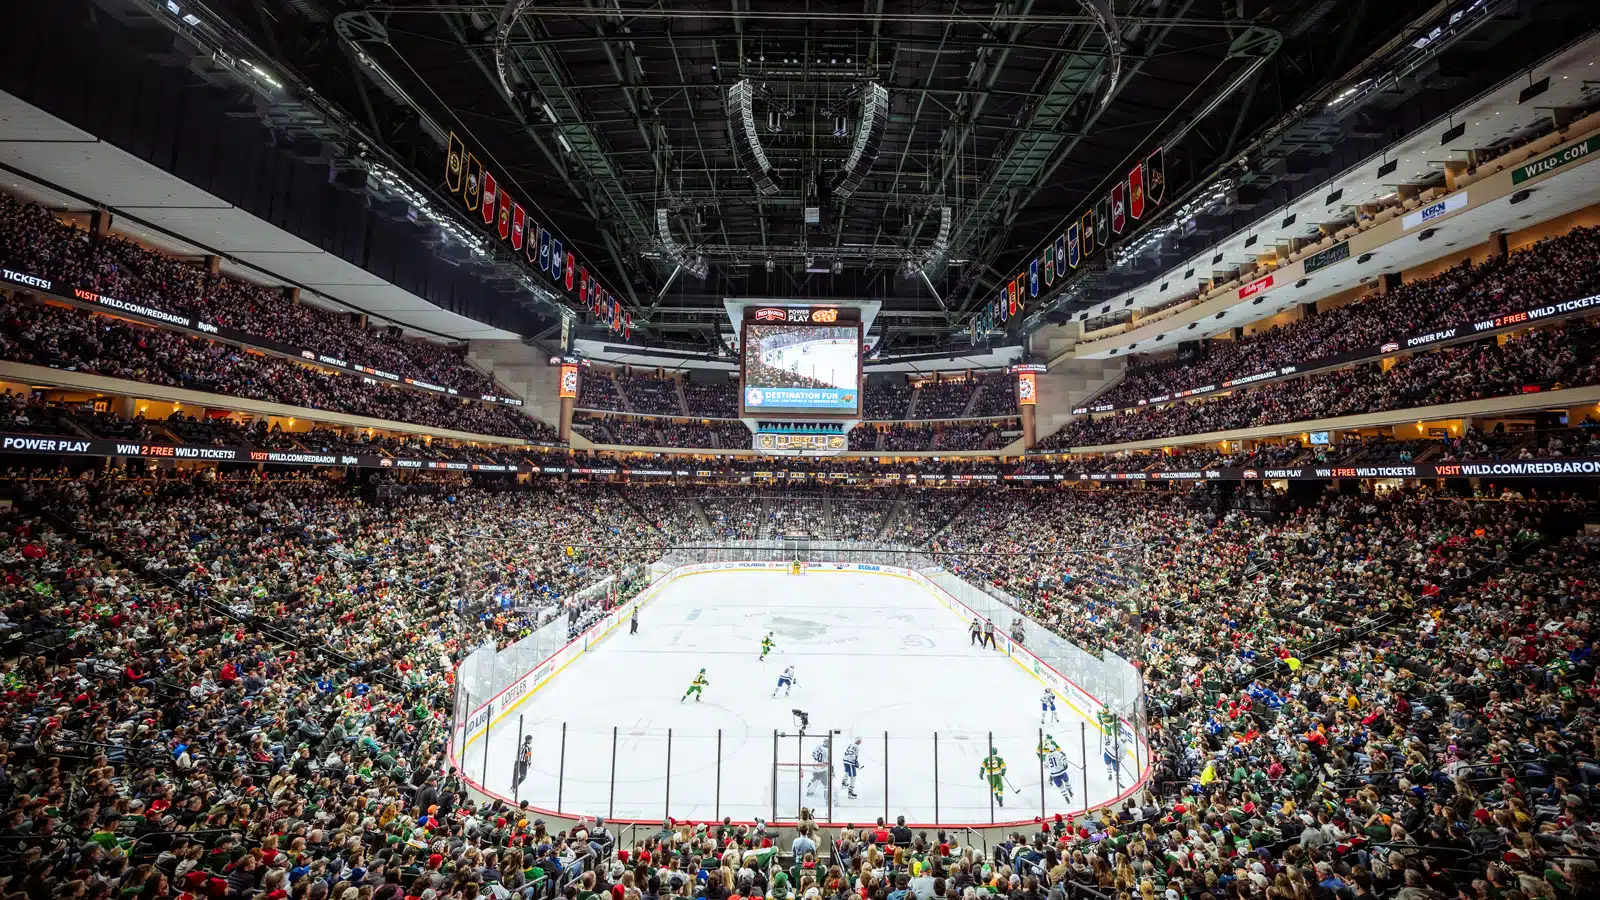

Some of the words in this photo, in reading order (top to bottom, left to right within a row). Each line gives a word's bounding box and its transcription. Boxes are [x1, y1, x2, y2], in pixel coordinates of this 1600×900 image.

[1525, 142, 1588, 177] WILD.COM
[4, 270, 51, 290] TICKETS!
[74, 288, 99, 302] VISIT
[100, 296, 190, 326] WILD.COM/REDBARON
[1474, 320, 1494, 330] WIN
[1504, 312, 1527, 324] FREE
[1528, 306, 1555, 318] WILD
[1407, 334, 1435, 346] POWER
[1436, 329, 1456, 340] PLAY
[320, 355, 335, 365] POWER
[336, 359, 347, 367] PLAY
[1232, 371, 1276, 386] WILD.COM/REDBARON
[3, 438, 55, 450] POWER
[58, 441, 91, 453] PLAY
[116, 445, 139, 455] WIN
[141, 446, 148, 455] 2
[150, 446, 174, 456] FREE
[175, 448, 198, 457] WILD
[200, 449, 235, 459] TICKETS!
[251, 451, 268, 461] VISIT
[269, 453, 336, 463] WILD.COM/REDBARON
[1356, 468, 1377, 476] WILD
[1378, 467, 1416, 476] TICKETS!
[1435, 466, 1460, 474] VISIT
[501, 680, 527, 706] LOFFLER
